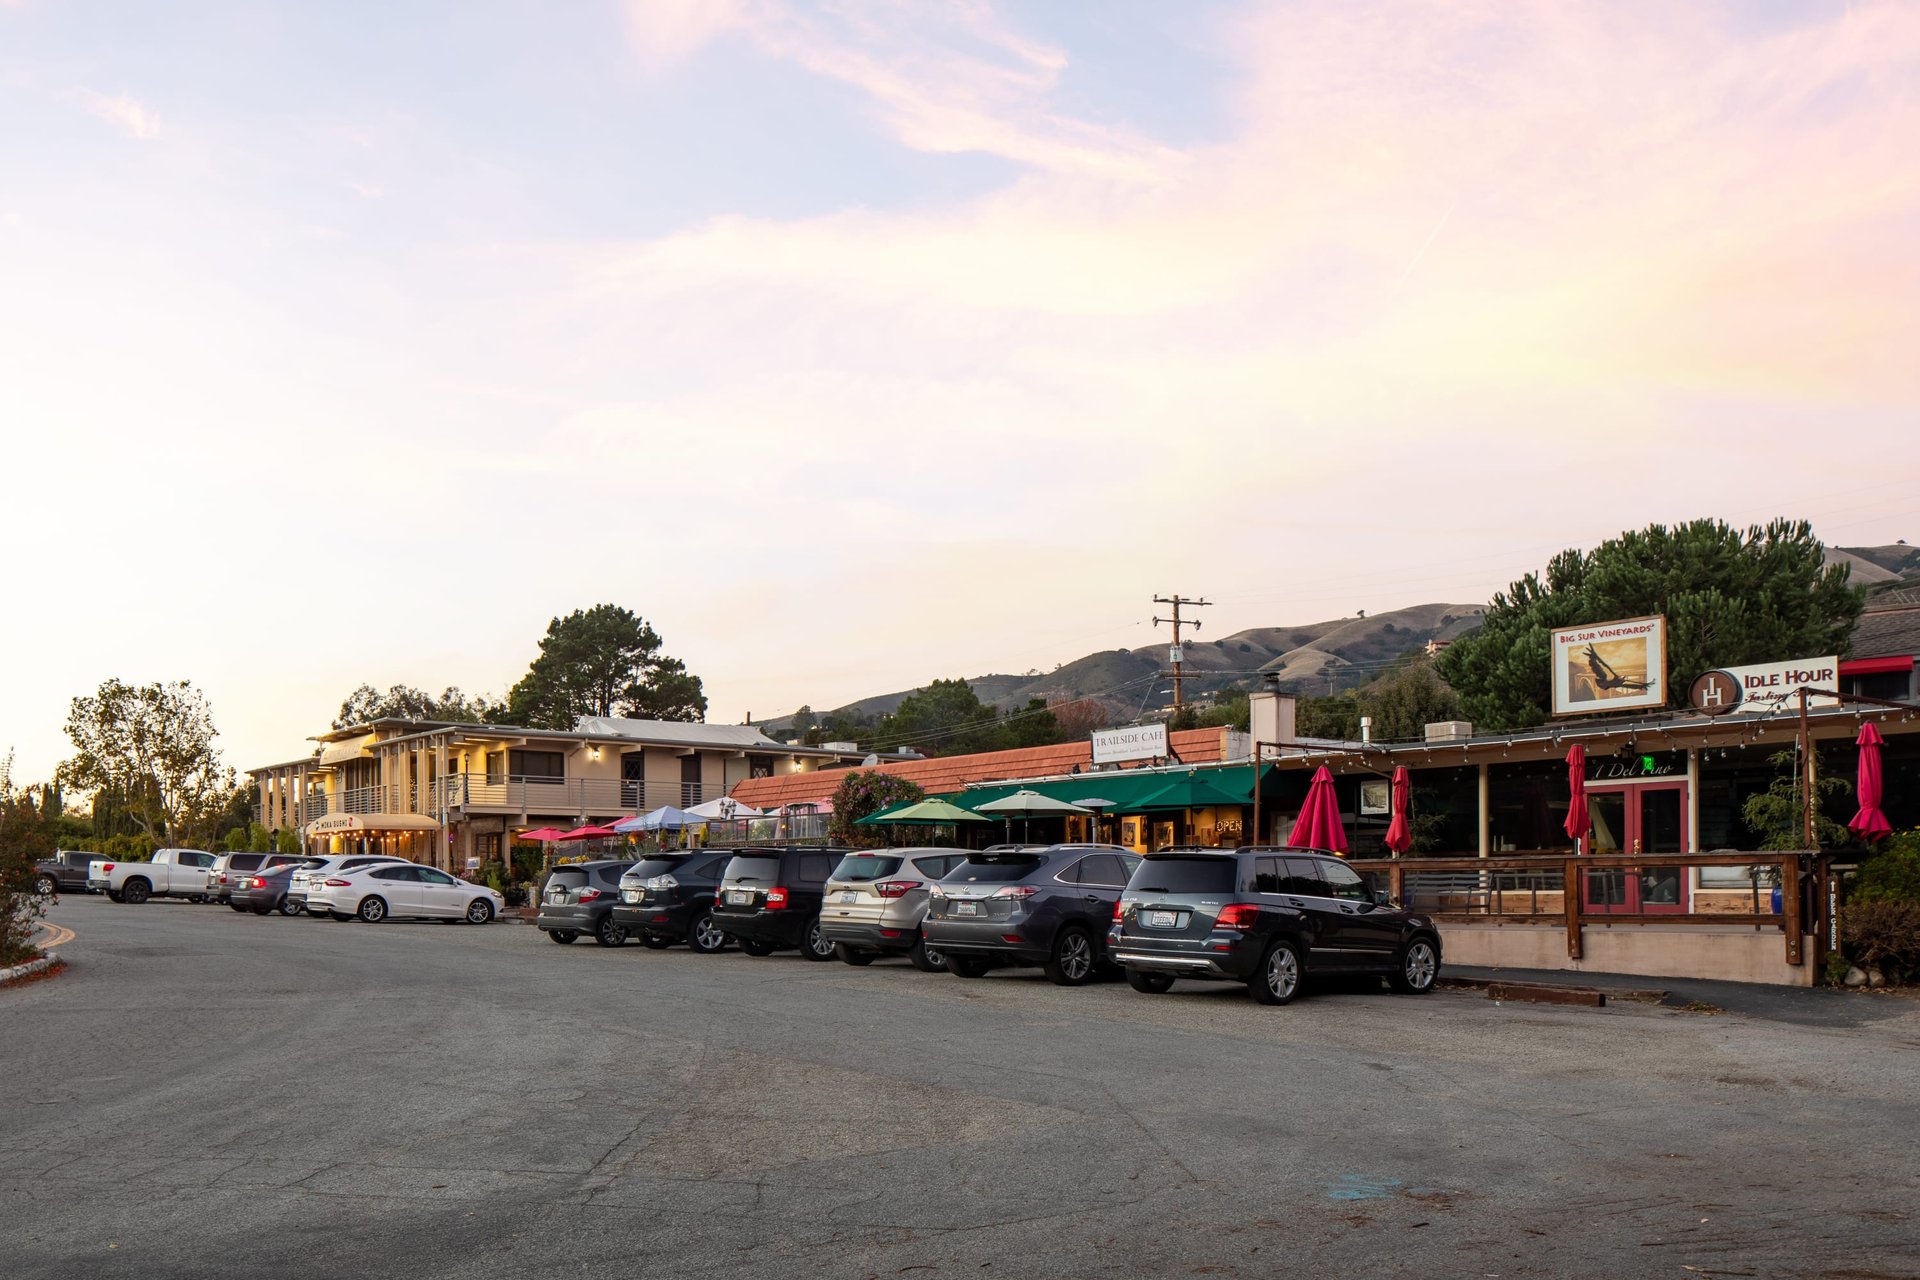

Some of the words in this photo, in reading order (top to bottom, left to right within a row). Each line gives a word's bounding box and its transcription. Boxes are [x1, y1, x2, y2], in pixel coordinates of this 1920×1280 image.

[1560, 635, 1575, 643] BIG
[1578, 632, 1596, 641] SUR
[1598, 625, 1651, 638] VINEYARDS
[1744, 673, 1780, 689] IDLE
[1784, 668, 1834, 685] HOUR
[1096, 733, 1140, 747] TRAILSIDE
[1141, 730, 1164, 742] CAFE
[1608, 757, 1640, 778] Del
[1216, 820, 1243, 832] OPEN
